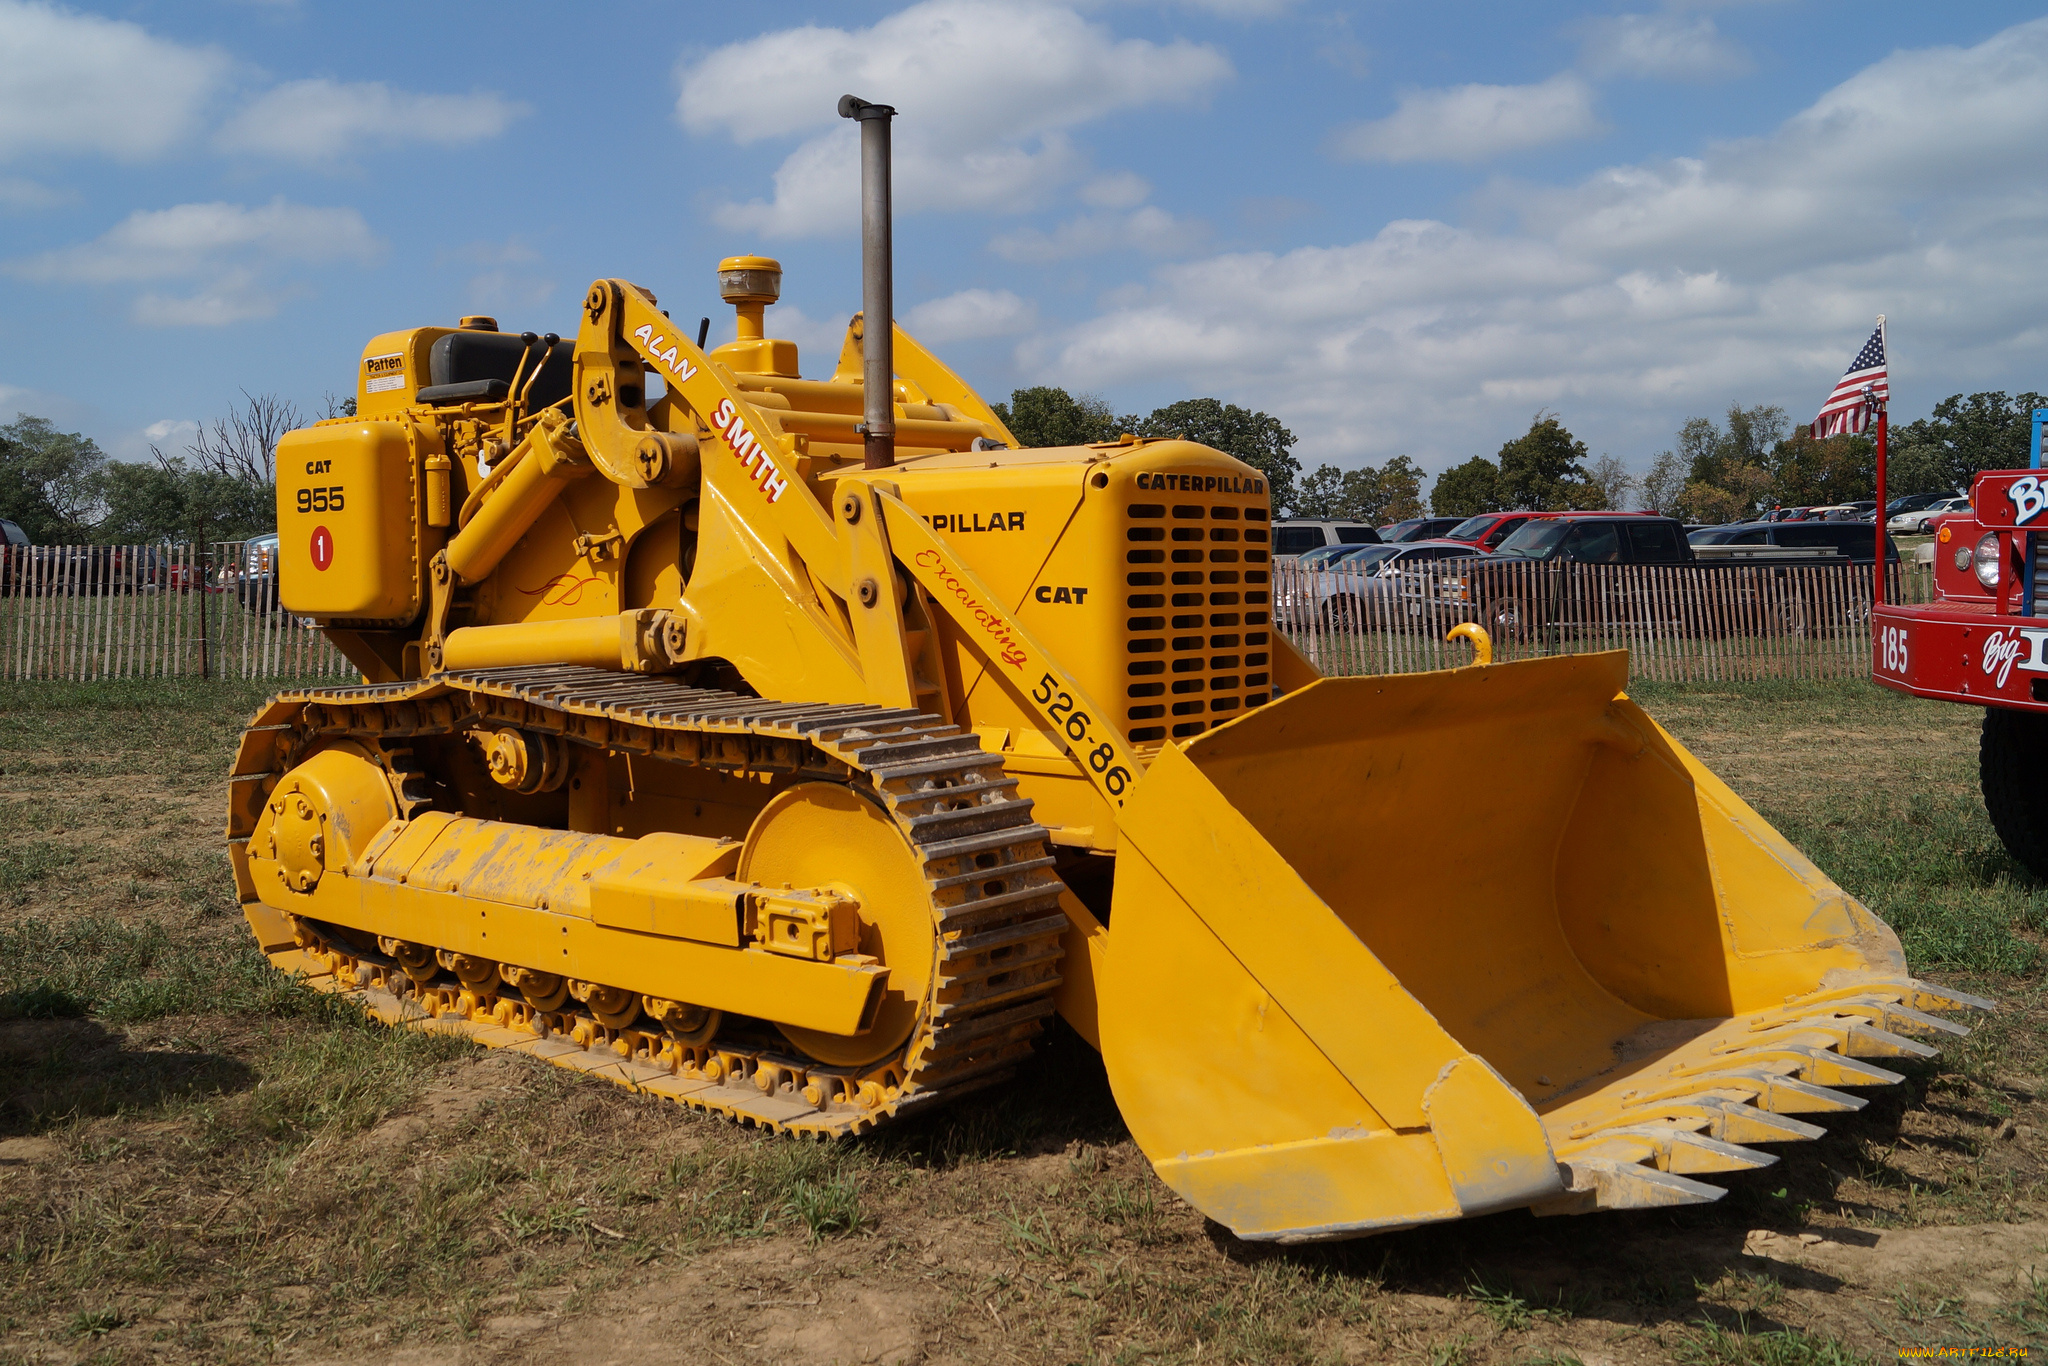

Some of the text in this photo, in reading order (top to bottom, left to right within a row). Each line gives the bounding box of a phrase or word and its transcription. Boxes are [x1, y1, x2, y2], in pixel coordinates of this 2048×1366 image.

[367, 357, 402, 372] Patten
[634, 323, 788, 504] ALAN SMITH
[305, 460, 332, 475] CAT
[1136, 473, 1264, 494] CATERPILLAR
[297, 486, 345, 513] 955
[2008, 476, 2048, 526] B
[921, 511, 1025, 533] PILLAR
[317, 535, 324, 562] 1
[1035, 585, 1088, 605] CAT
[915, 549, 1028, 672] Excavating
[1881, 625, 1908, 674] 185
[1982, 626, 2025, 689] Big
[1032, 672, 1136, 808] 526-86
